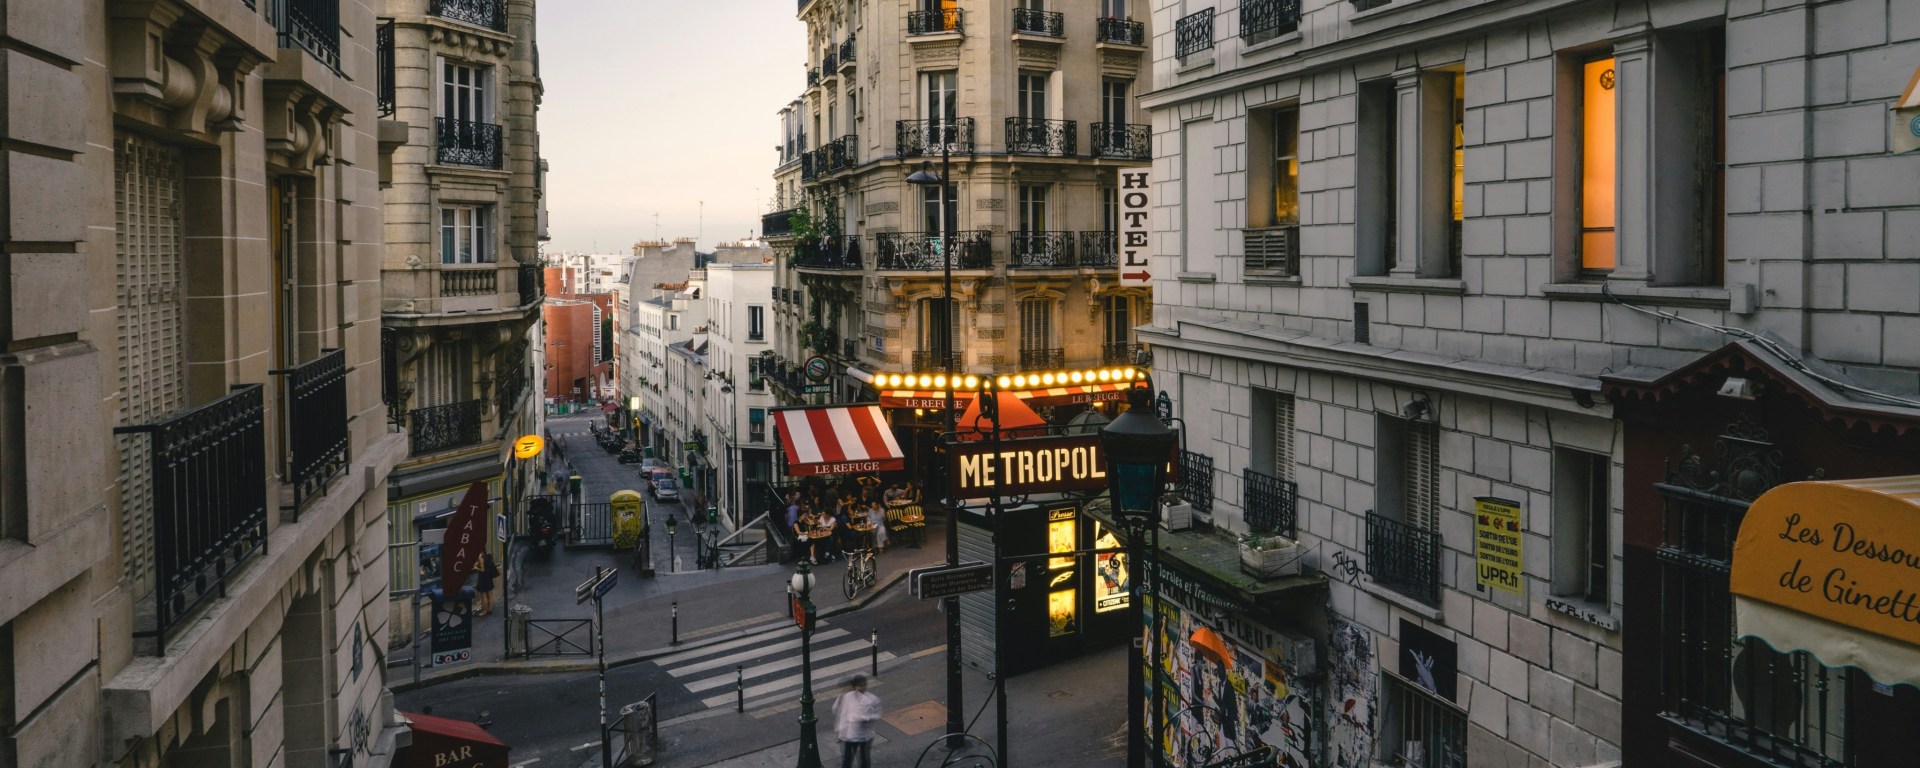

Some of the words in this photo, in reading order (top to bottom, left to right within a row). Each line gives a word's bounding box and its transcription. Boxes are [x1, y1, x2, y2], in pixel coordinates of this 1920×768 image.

[1122, 172, 1149, 267] HOTEL
[905, 399, 919, 407] LE
[1072, 395, 1084, 404] LE
[815, 464, 830, 474] LE
[833, 461, 880, 473] REFUGE
[1778, 513, 1824, 546] Les
[453, 504, 479, 572] TABAC
[1479, 530, 1498, 541] SORTIR
[1498, 533, 1506, 543] DE
[1479, 541, 1496, 552] SORTIR
[1496, 545, 1502, 553] DE
[1479, 552, 1496, 562] SORTIR
[1495, 556, 1502, 564] DE
[1779, 558, 1814, 593] de
[435, 650, 470, 664] LOTO
[434, 745, 473, 768] BAR
